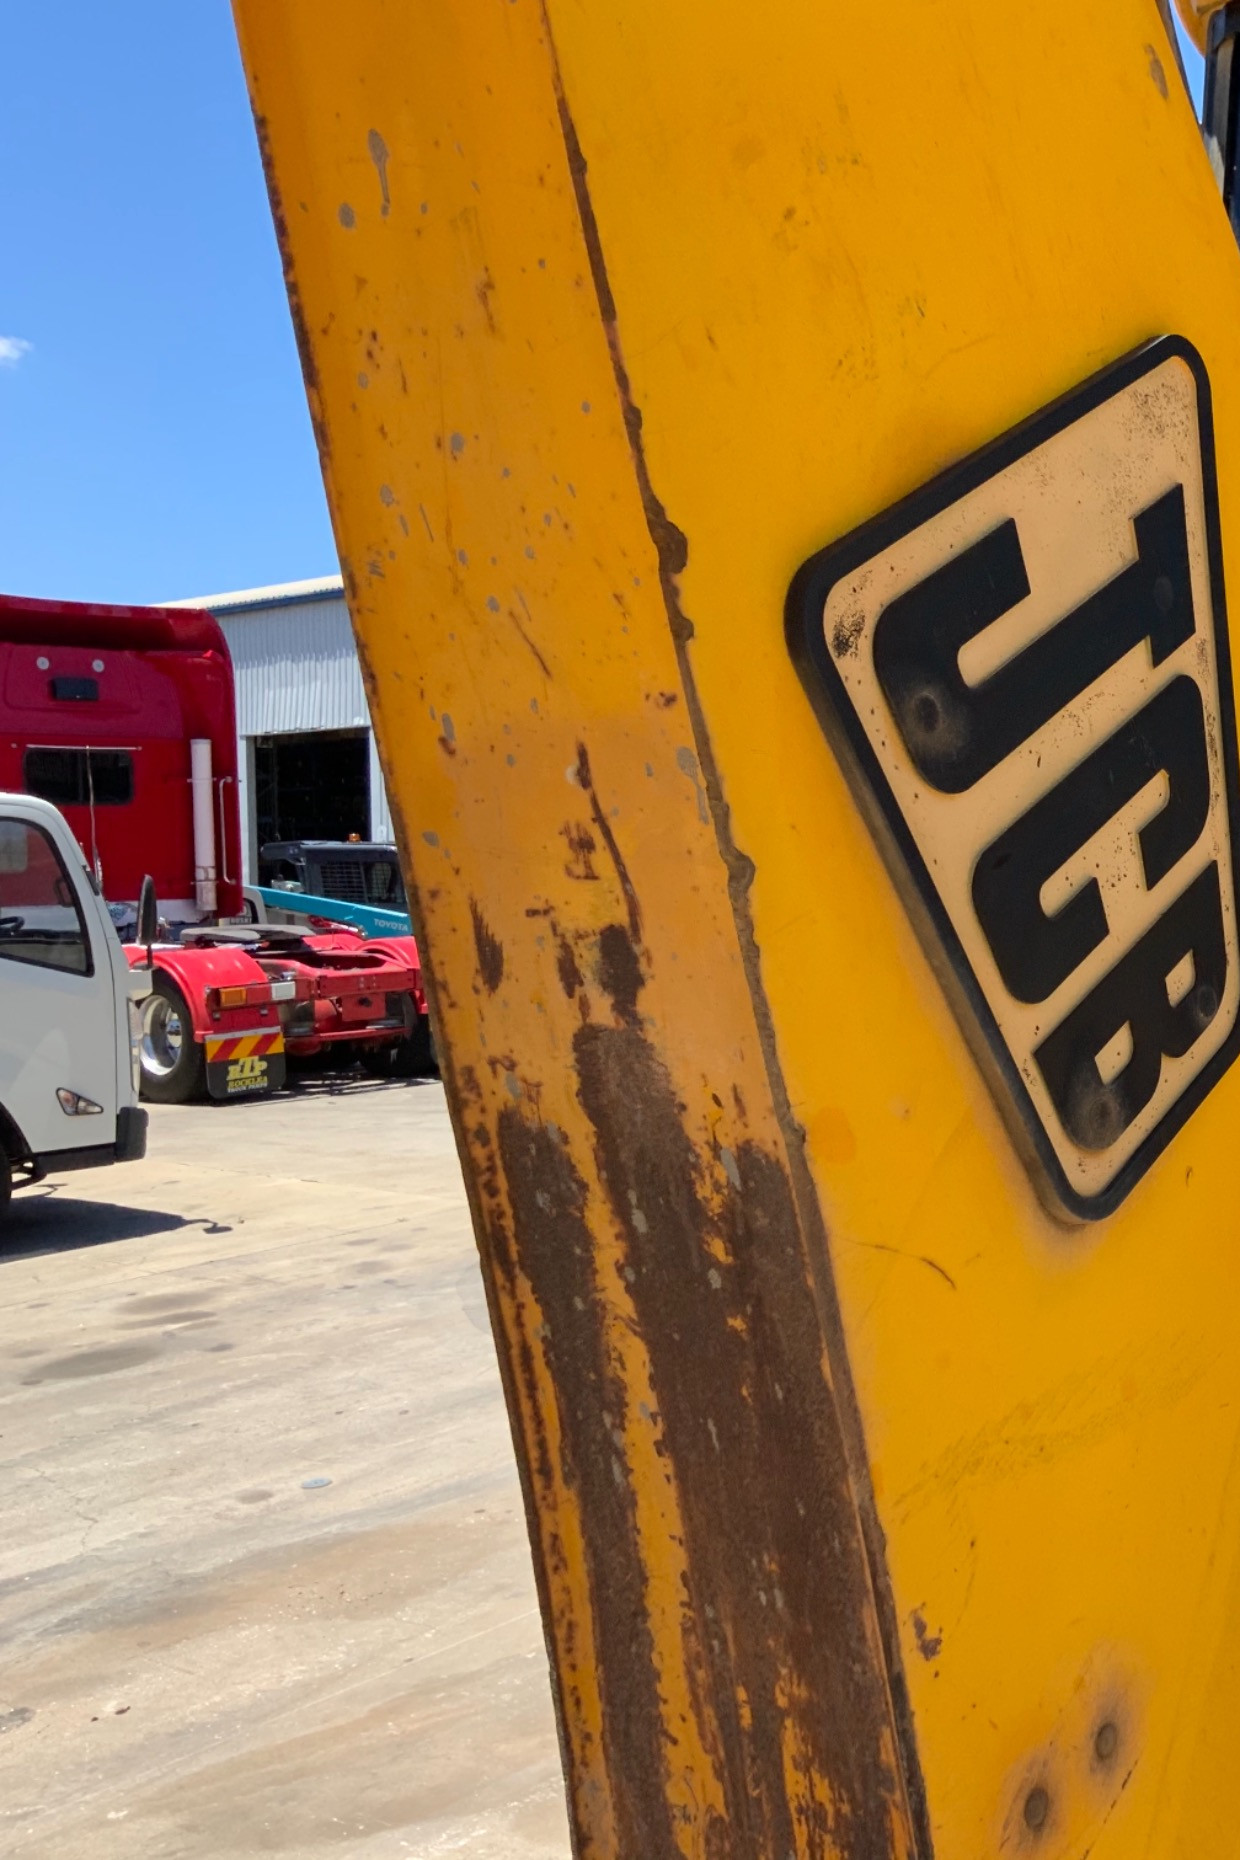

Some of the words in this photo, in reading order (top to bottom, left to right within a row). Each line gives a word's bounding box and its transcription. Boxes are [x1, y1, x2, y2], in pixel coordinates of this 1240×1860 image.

[873, 482, 1228, 1151] JCB
[374, 918, 408, 931] TOYOTA
[226, 1056, 268, 1080] RTP
